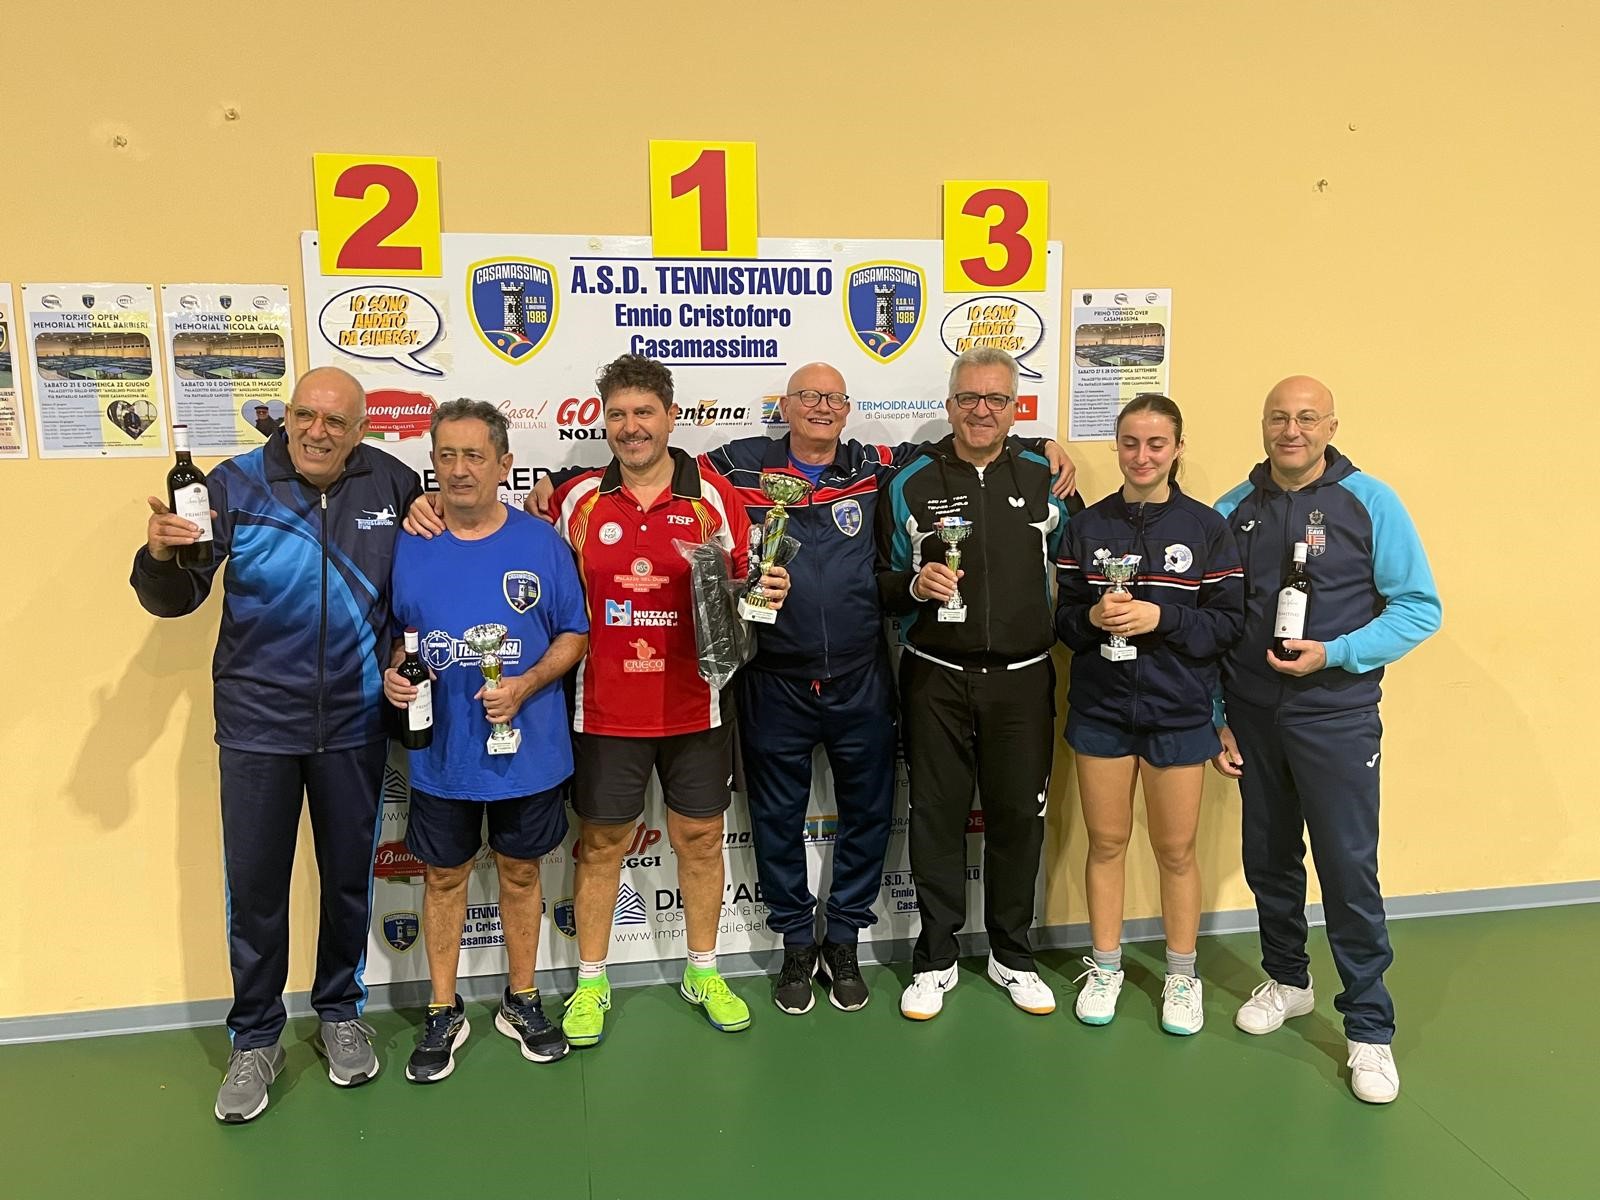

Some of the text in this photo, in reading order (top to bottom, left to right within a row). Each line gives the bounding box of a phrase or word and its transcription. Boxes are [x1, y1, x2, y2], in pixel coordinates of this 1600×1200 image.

[671, 149, 728, 252] 1
[333, 163, 423, 270] 2
[960, 188, 1033, 287] 3
[476, 264, 548, 285] CASAMASSIMA
[570, 265, 832, 296] A.S.D. TENNISTAVOLO
[852, 268, 917, 287] CASAMASSIMA
[349, 294, 409, 312] IO SONO
[195, 314, 258, 322] TORNEO OPEN
[526, 310, 547, 323] 1988
[615, 303, 672, 327] Ennio
[896, 311, 915, 324] 1988
[967, 304, 1018, 320] IO SONO
[33, 321, 75, 329] MEMORIAL
[77, 321, 111, 329] MICHAEL
[352, 312, 408, 329] ANDATO
[968, 320, 1016, 336] ANDATO
[338, 330, 358, 346] DA
[630, 334, 778, 358] Casamassima
[956, 337, 973, 352] DA
[365, 403, 433, 419] uongustai
[675, 403, 746, 420] entana
[857, 400, 945, 411] TERMOIDRAULICA
[865, 411, 937, 420] di Giuseppe Marotti
[508, 421, 547, 429] OBILIARI
[666, 514, 695, 526] TSP
[633, 610, 678, 619] NUZZACI
[633, 618, 672, 627] STRADE
[891, 888, 914, 898] Ennio
